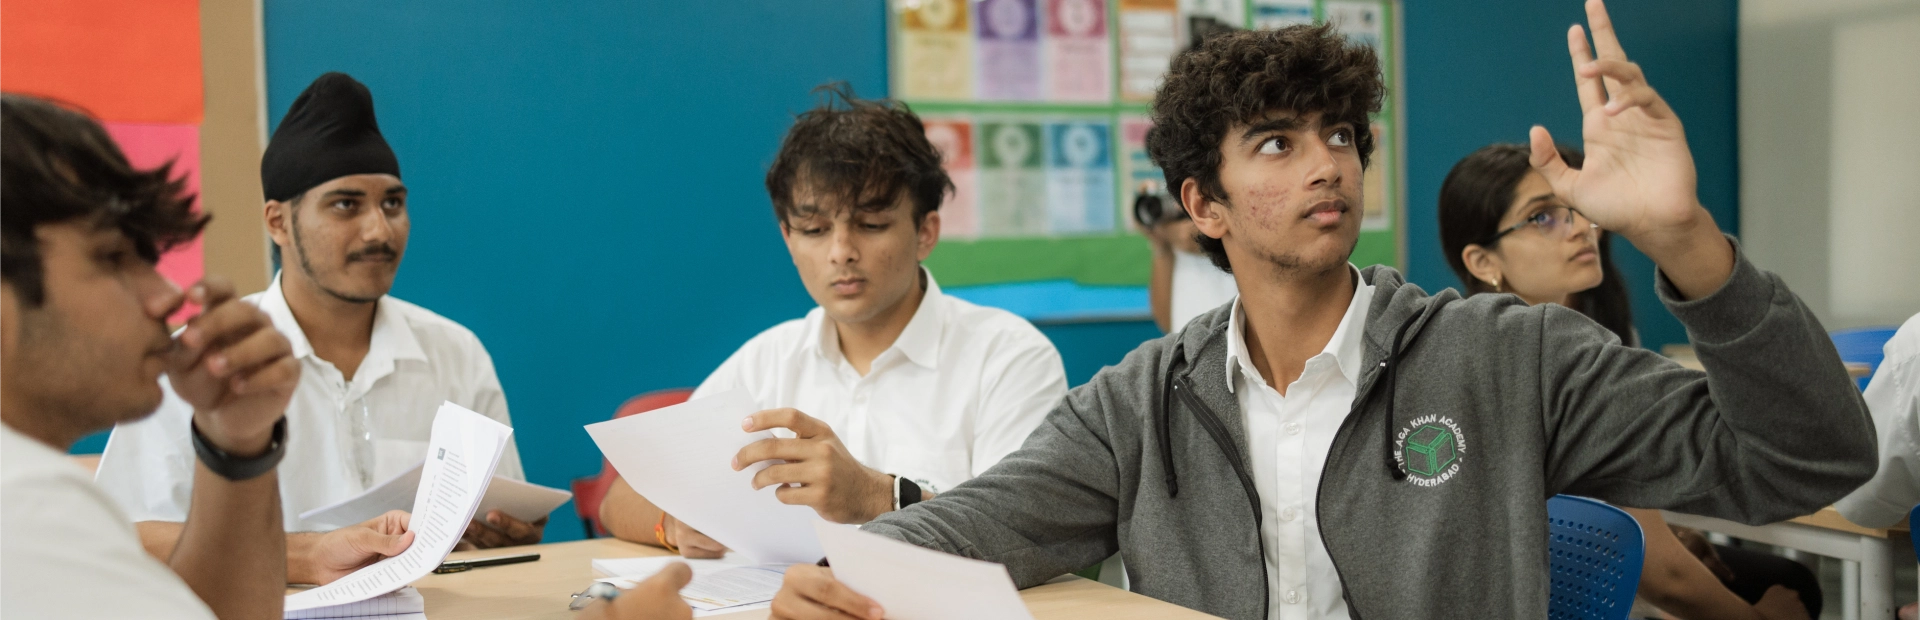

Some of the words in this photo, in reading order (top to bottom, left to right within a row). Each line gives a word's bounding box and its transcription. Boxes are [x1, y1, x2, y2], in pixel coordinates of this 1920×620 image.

[1396, 427, 1410, 448] AGA
[1410, 413, 1437, 428] KHAN
[1439, 416, 1466, 453] ACADEMY
[1406, 464, 1459, 487] HYDERABAD
